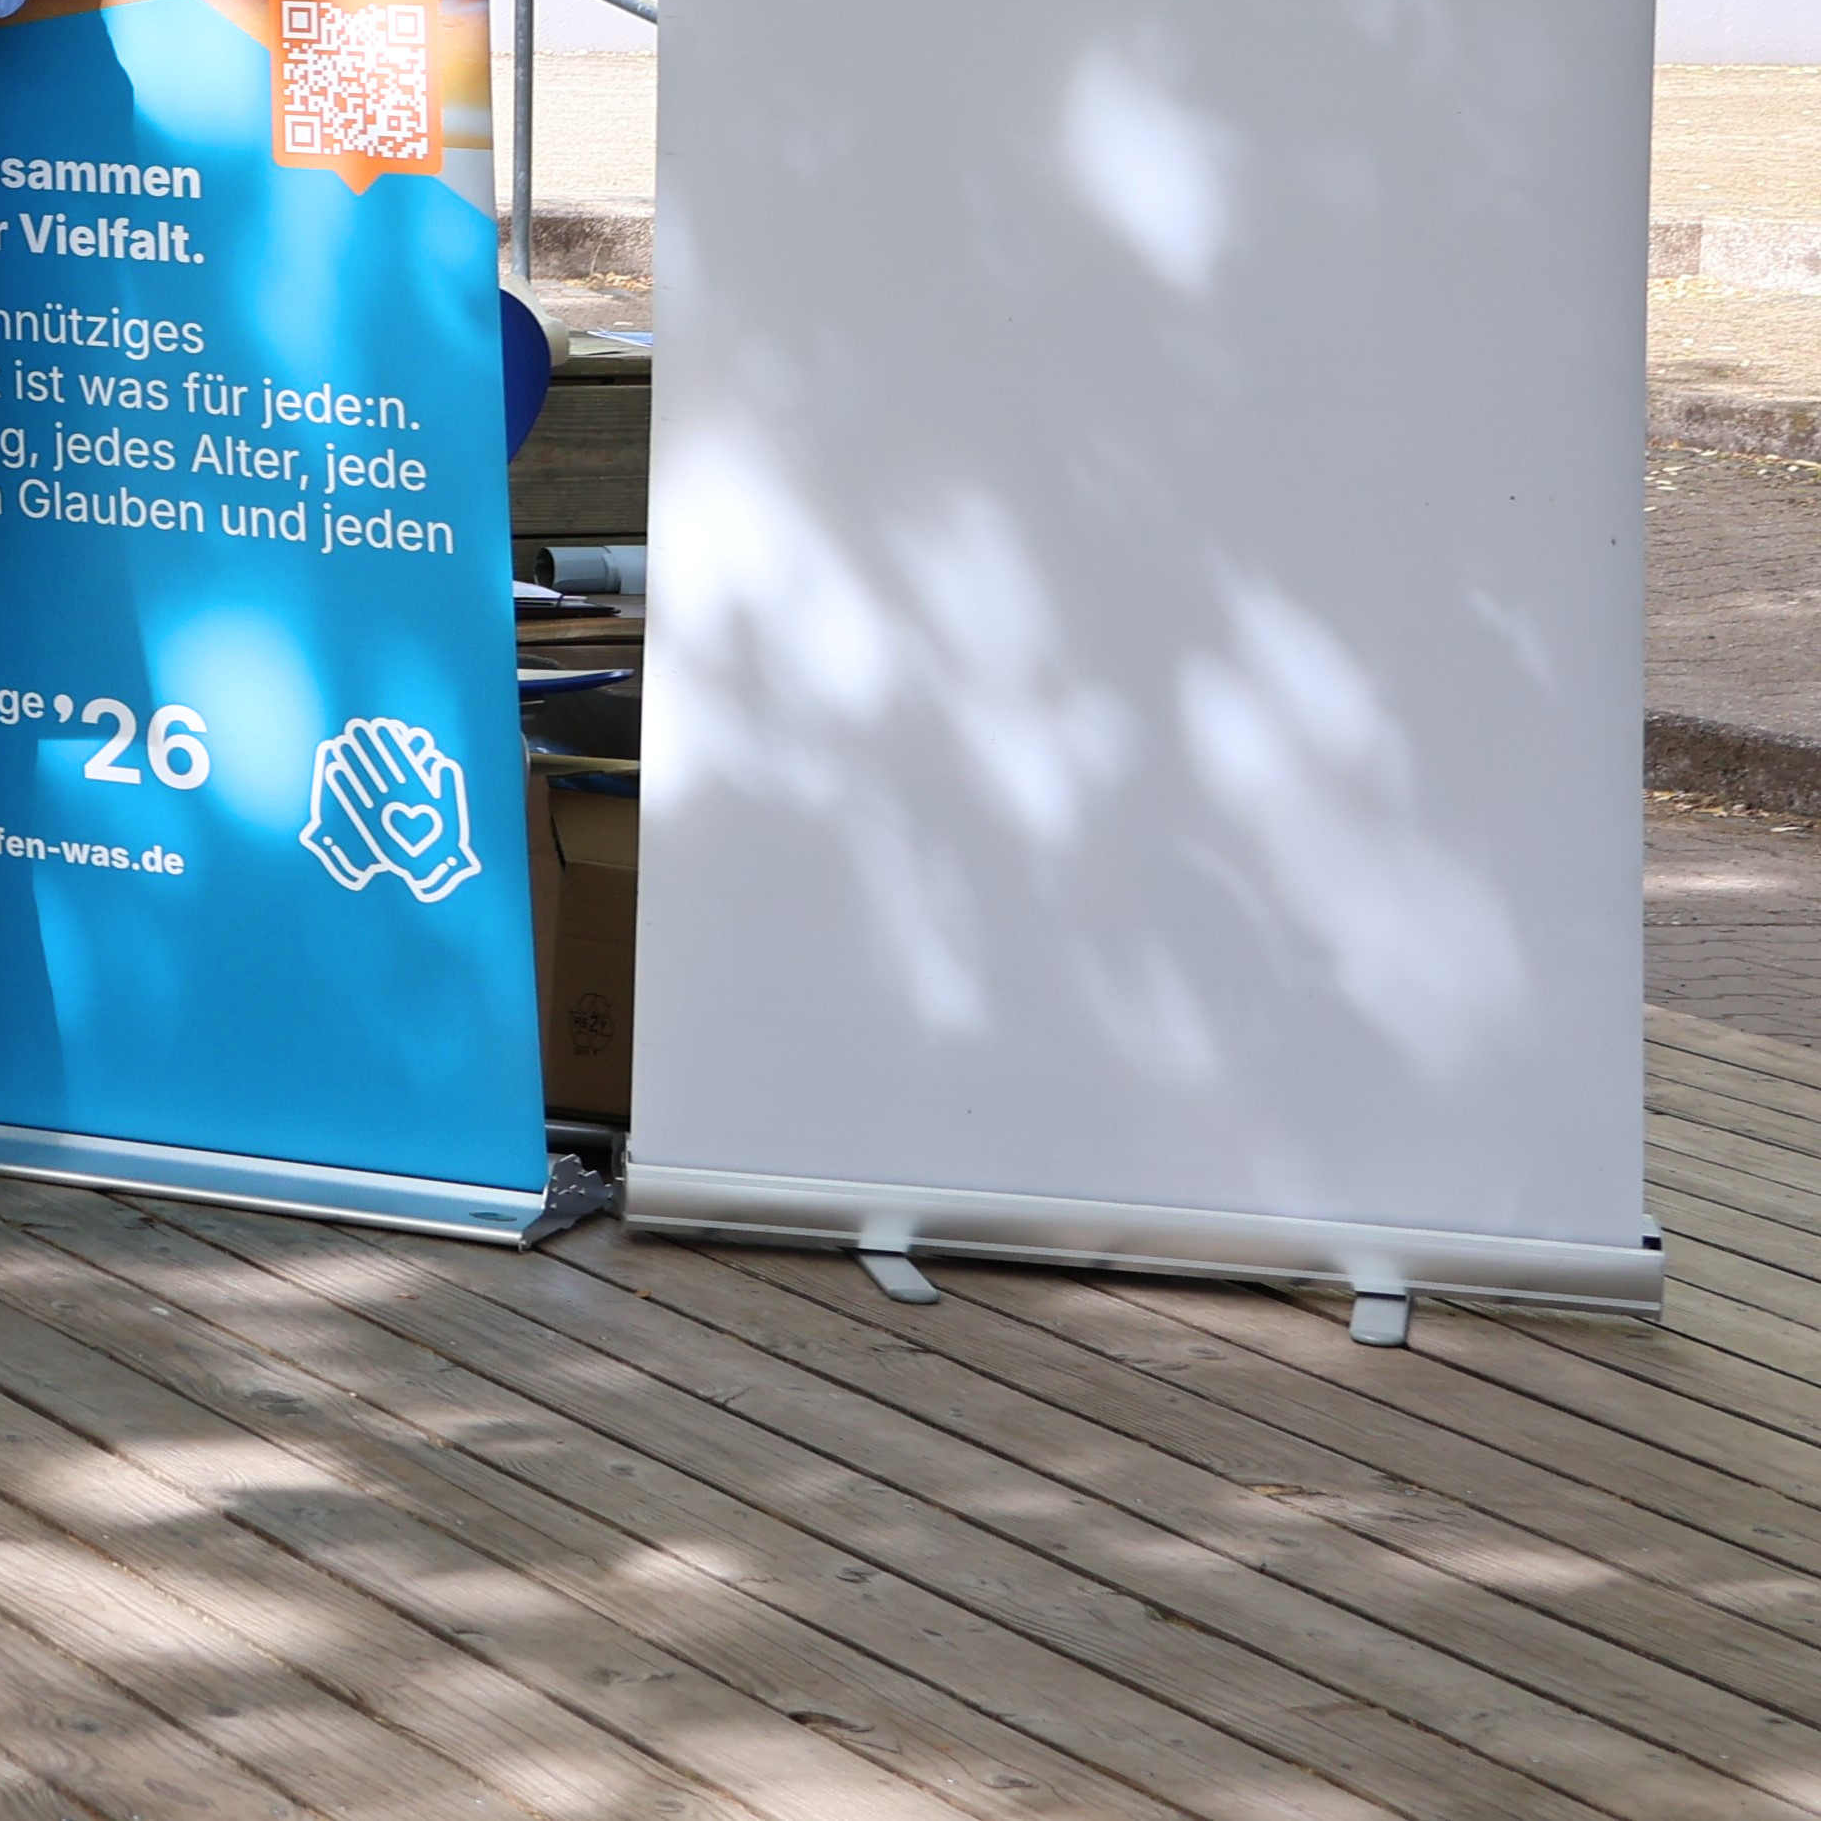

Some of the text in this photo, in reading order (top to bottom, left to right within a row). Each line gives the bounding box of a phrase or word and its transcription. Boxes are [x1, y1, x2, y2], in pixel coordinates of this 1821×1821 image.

[20, 212, 206, 265] Vielfalt.
[15, 364, 65, 405] ist
[78, 375, 170, 412] was
[182, 371, 249, 418] für
[260, 378, 421, 433] jede:n.
[53, 420, 177, 472] jedes
[191, 432, 310, 491] Alter,
[324, 442, 428, 497] jede
[17, 478, 206, 534] Glauben
[220, 499, 307, 543] und
[320, 502, 456, 555] jeden
